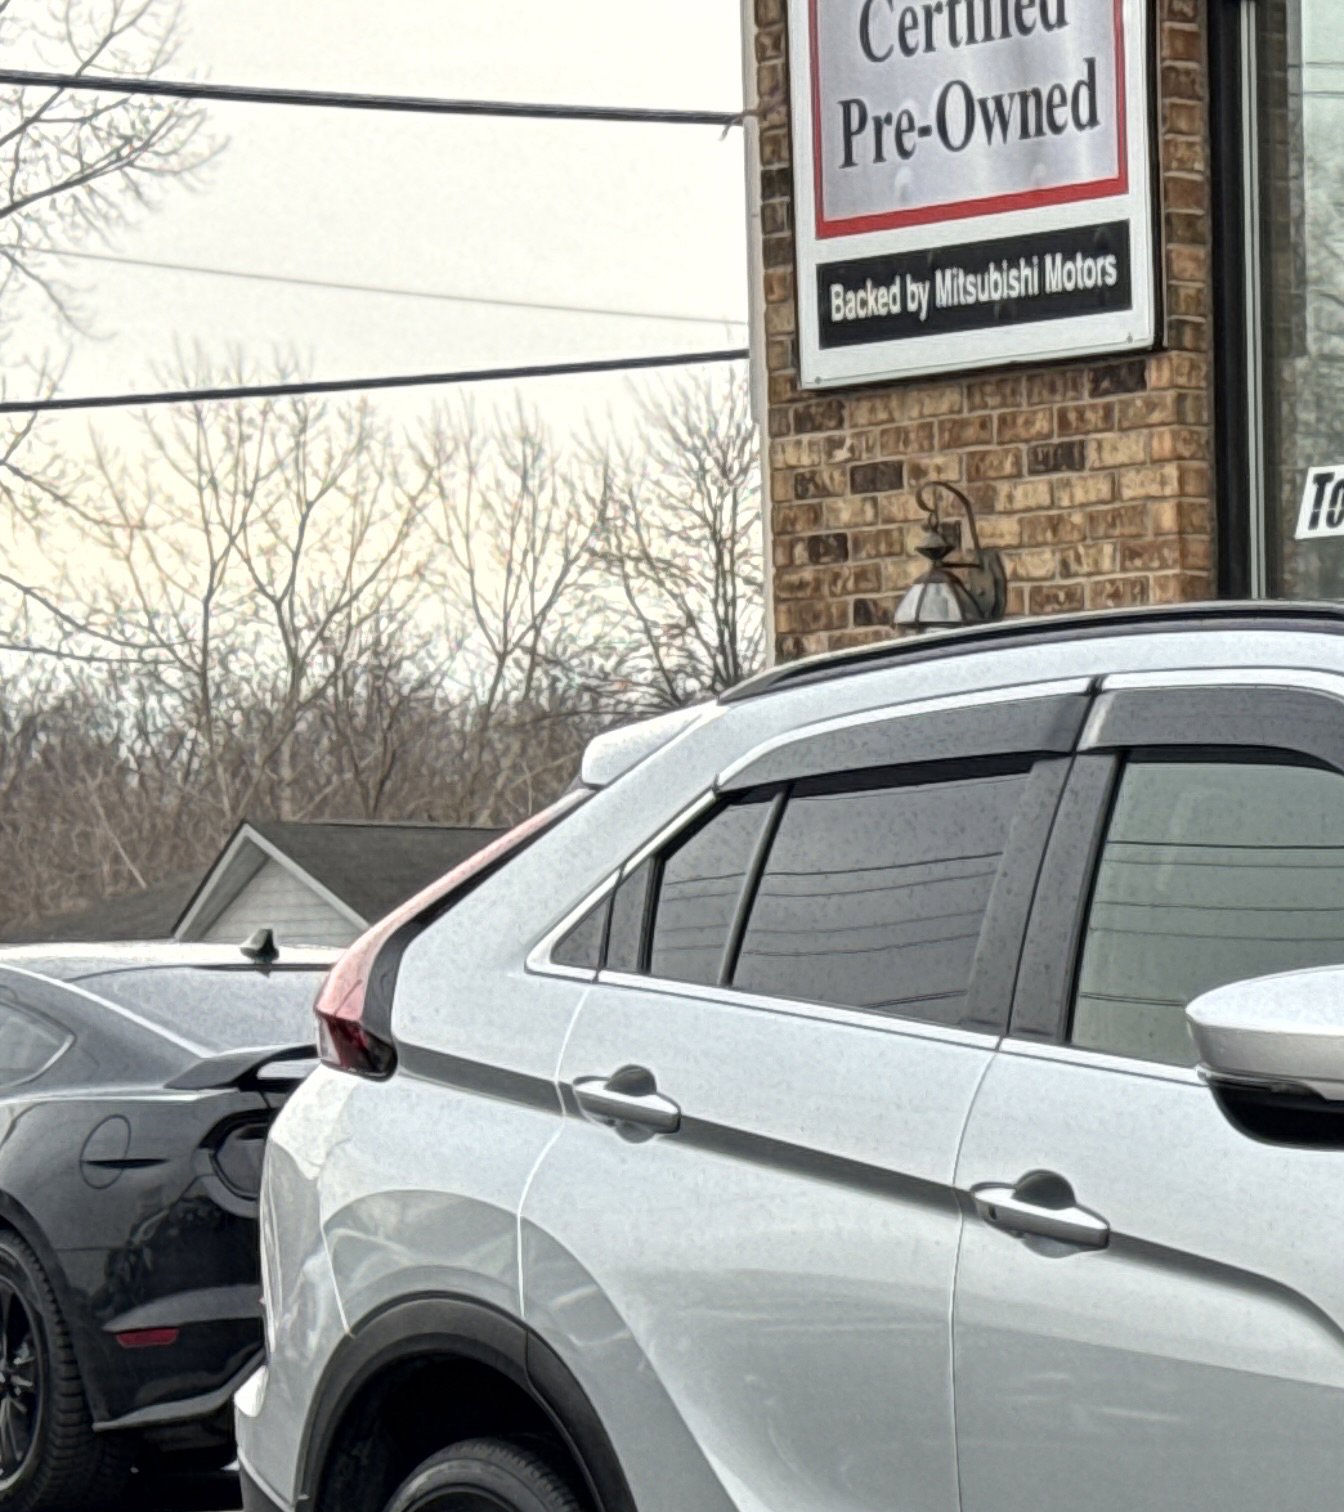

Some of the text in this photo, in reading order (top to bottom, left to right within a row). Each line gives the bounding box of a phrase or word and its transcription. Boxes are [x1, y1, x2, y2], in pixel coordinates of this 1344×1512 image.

[838, 57, 1101, 169] Pre-Owned
[830, 251, 1118, 322] Backed by Mitsubishi Motors
